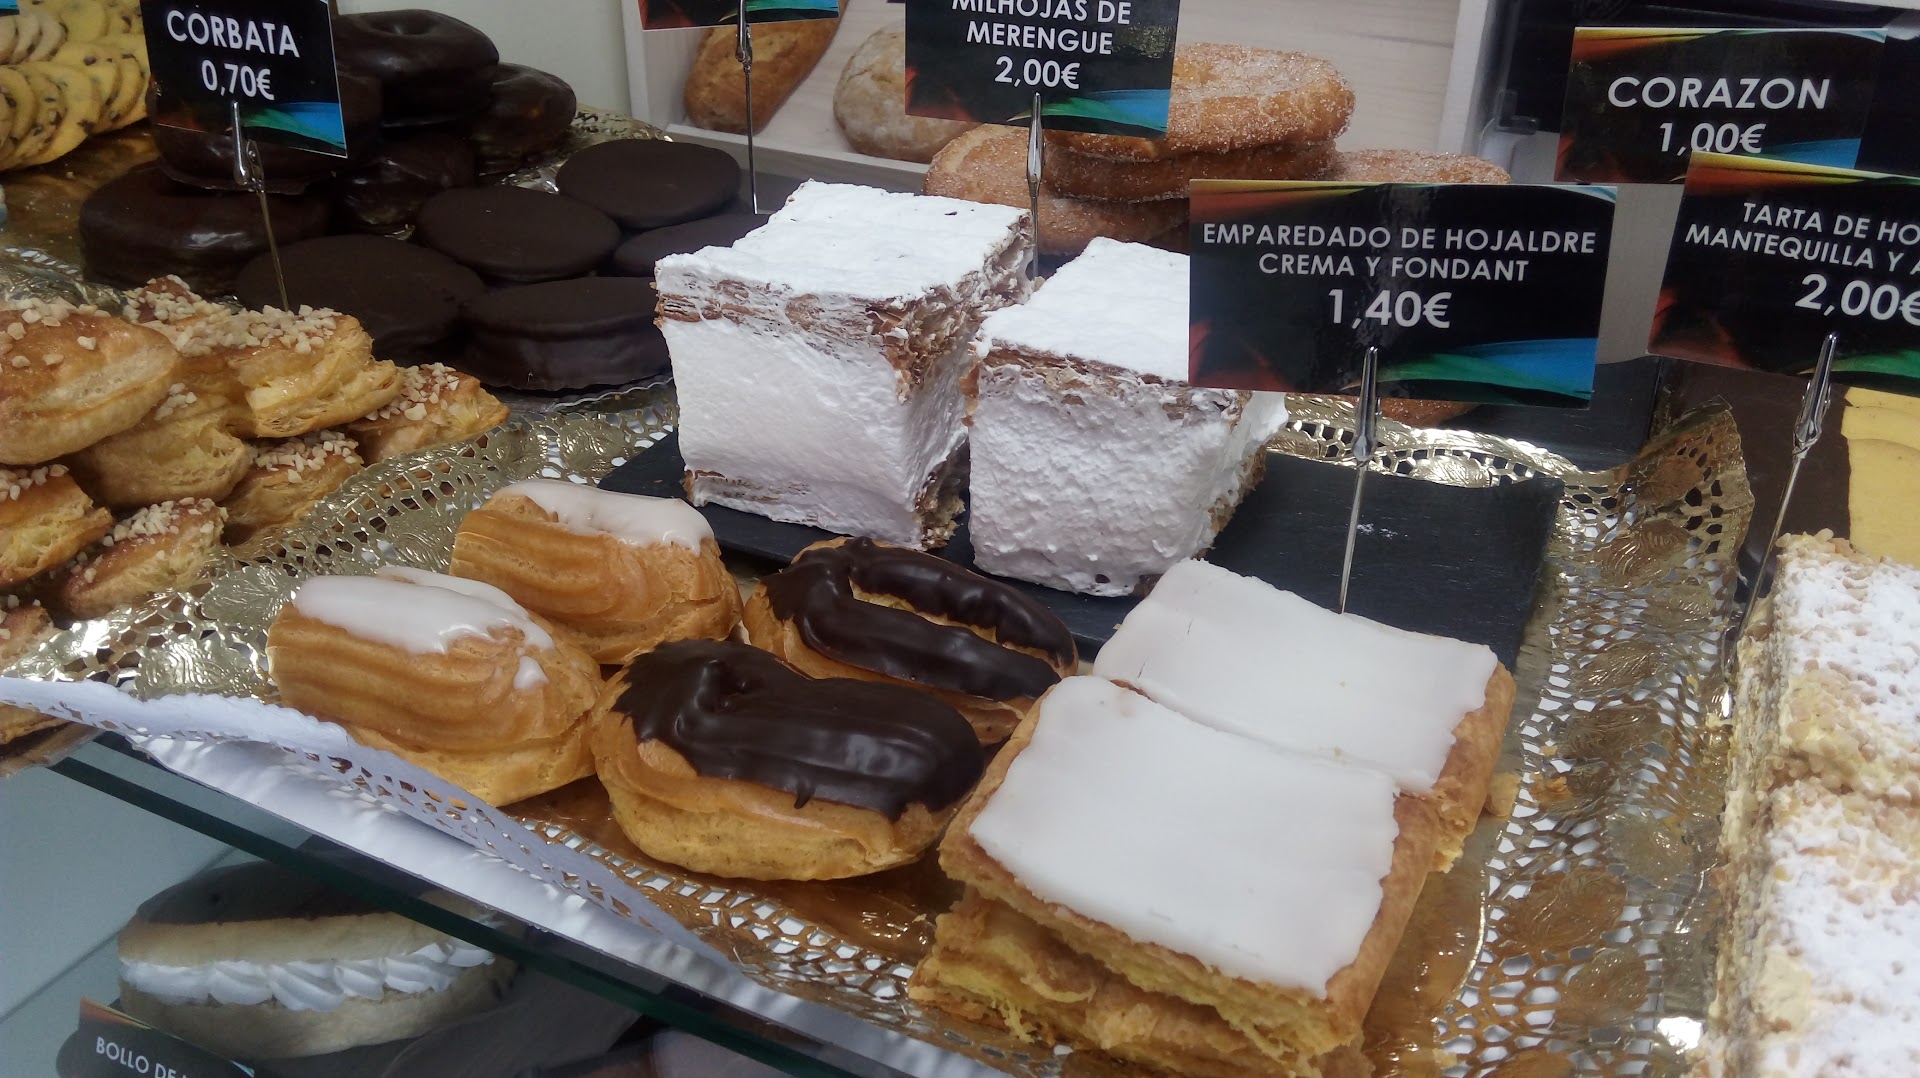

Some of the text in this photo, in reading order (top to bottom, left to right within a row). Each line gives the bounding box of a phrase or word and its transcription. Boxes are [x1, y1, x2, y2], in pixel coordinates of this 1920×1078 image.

[1097, 0, 1132, 24] DE
[166, 10, 300, 58] CORBATA
[966, 20, 1113, 55] MERENGUE
[201, 59, 275, 100] 0,70€
[994, 56, 1081, 90] 2,00€
[1607, 76, 1830, 110] CORAZON
[1659, 122, 1767, 156] 1,00€
[1203, 223, 1597, 254] EMPAREDADO DE HOJALDRE
[1743, 202, 1823, 233] TARTA
[1834, 215, 1871, 239] DE
[1685, 223, 1874, 269] MANTEQUILLA
[1888, 251, 1905, 272] Y
[1258, 252, 1529, 282] CREMA Y FONDANT
[1327, 289, 1453, 330] 1,40€
[1795, 273, 1920, 326] 2,00€
[96, 1036, 150, 1074] BOLLO
